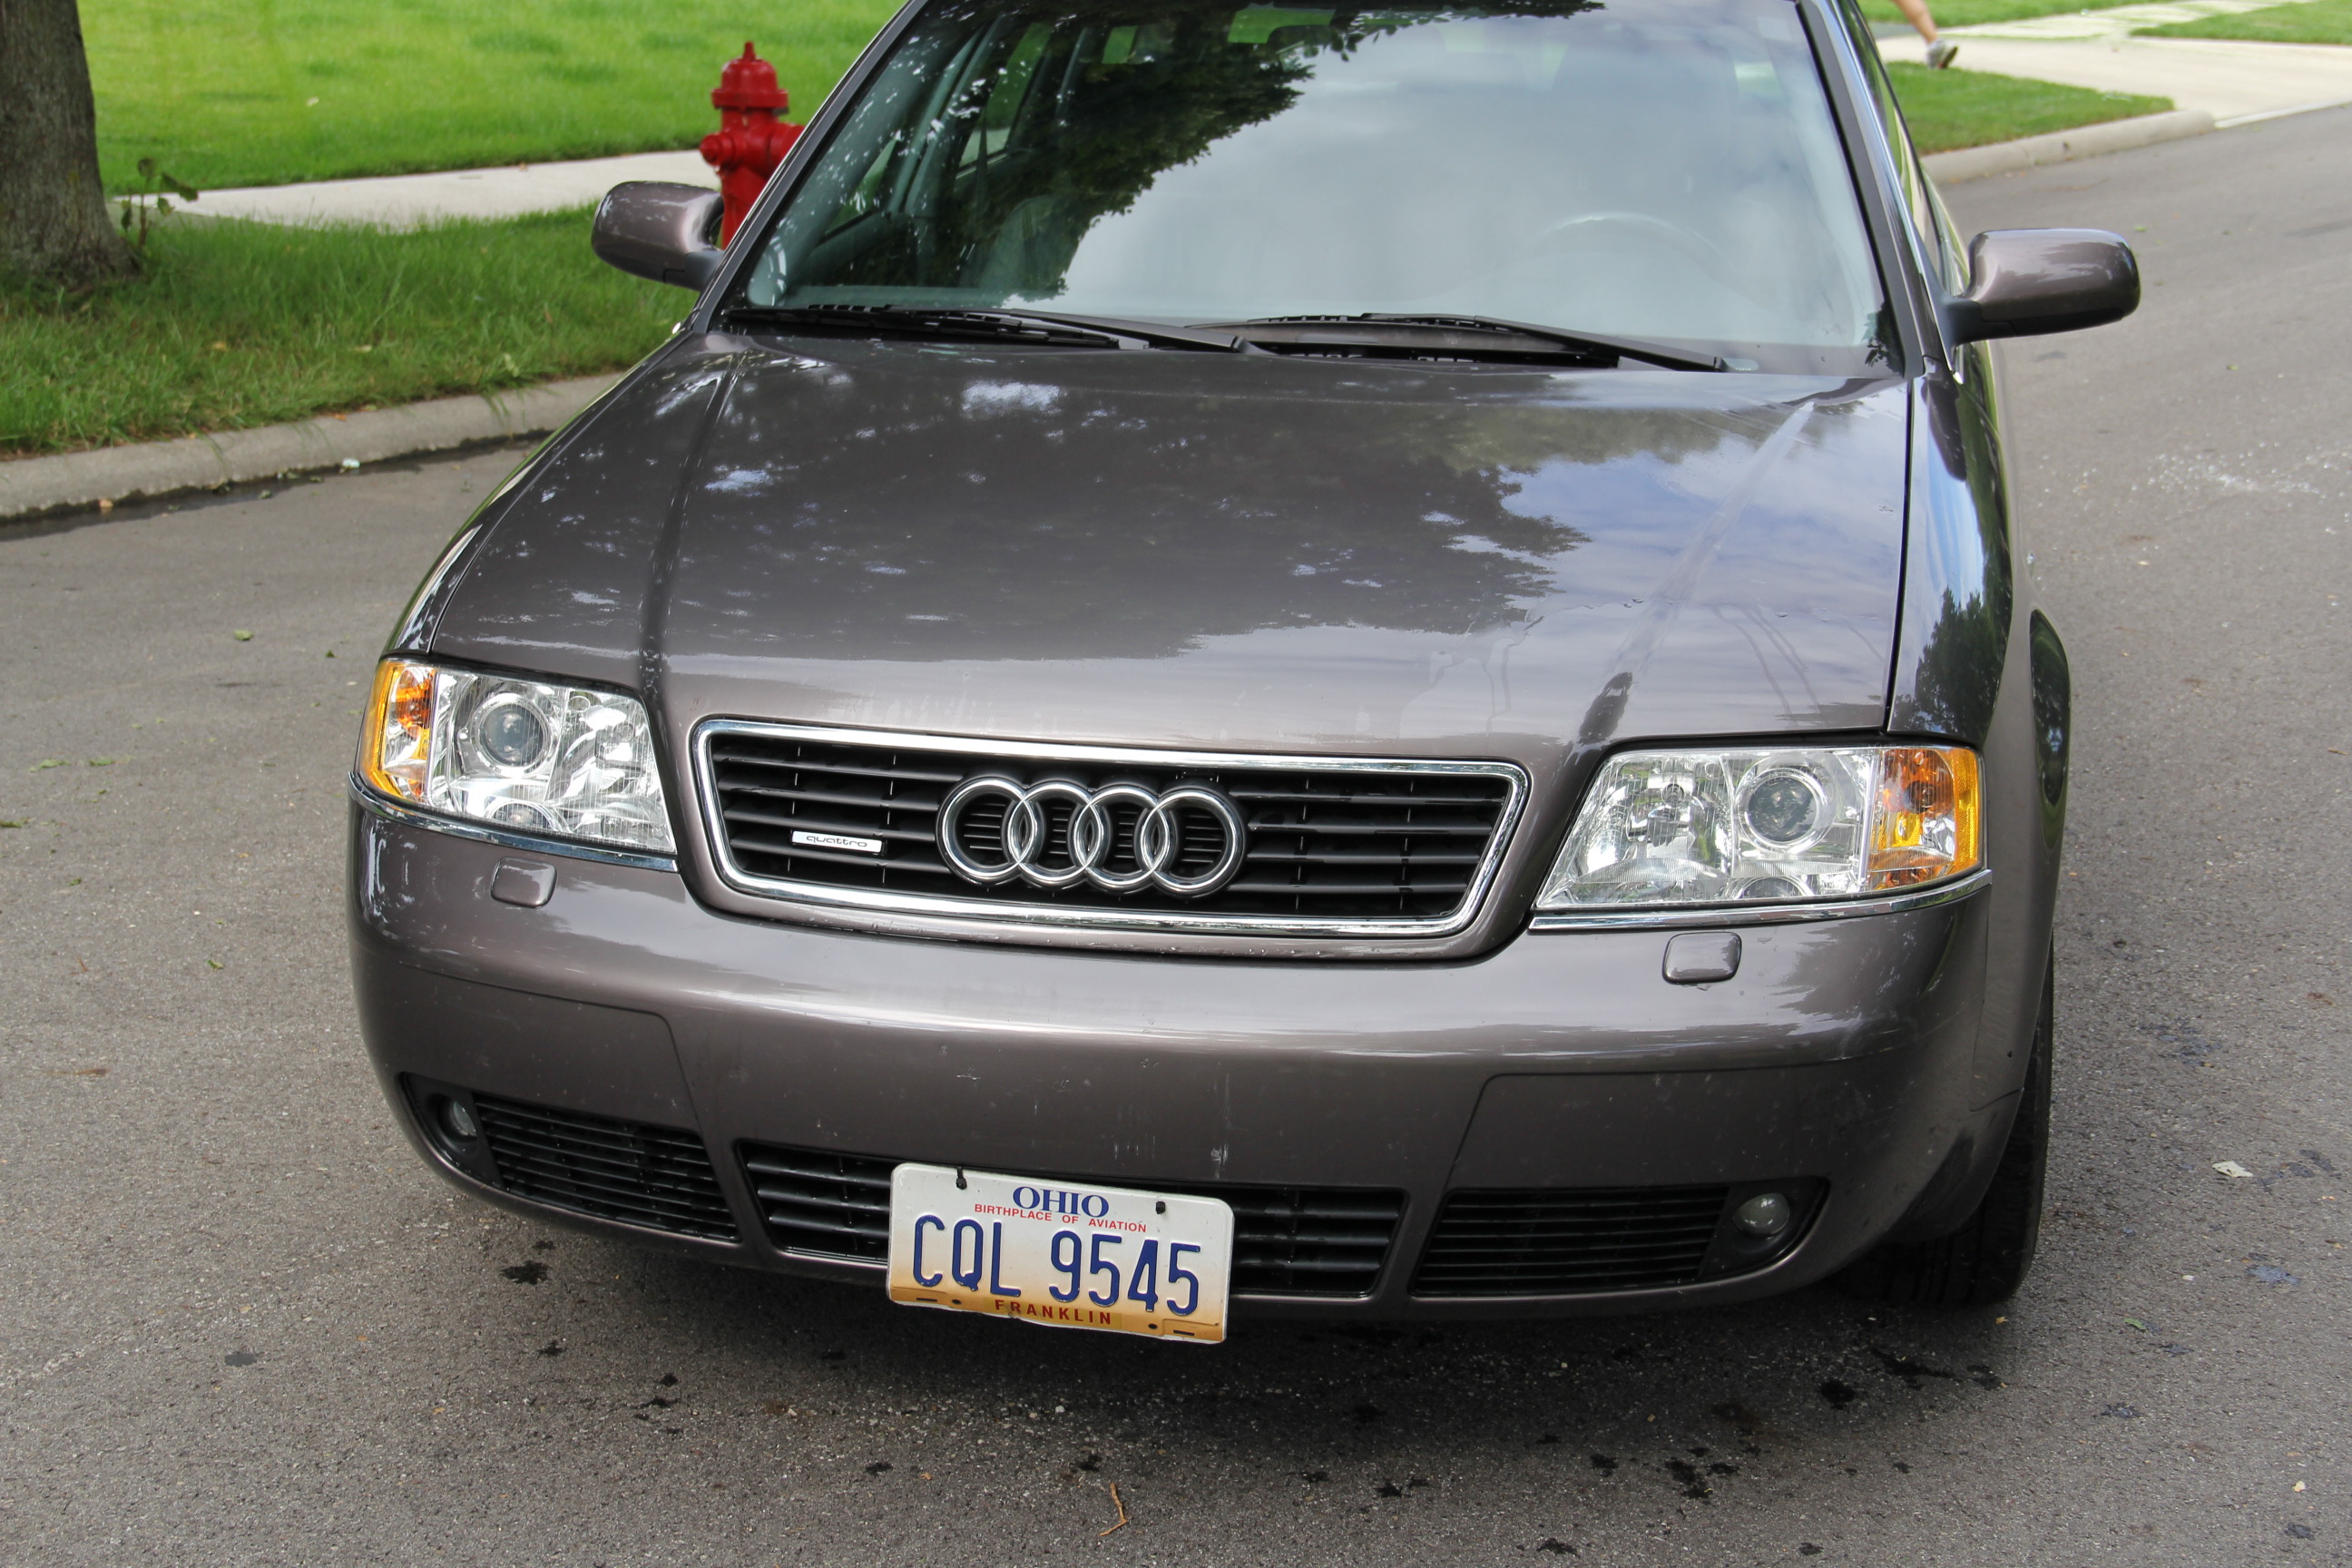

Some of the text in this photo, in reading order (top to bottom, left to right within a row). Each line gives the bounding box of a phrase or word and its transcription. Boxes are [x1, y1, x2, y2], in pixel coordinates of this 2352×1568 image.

[806, 835, 868, 848] quattro
[1013, 1186, 1110, 1218] OHIO
[974, 1203, 1147, 1233] BIRTHPLACE OF AVIATION
[913, 1215, 1201, 1316] CQL 9545
[995, 1299, 1112, 1325] FRANKLIN
